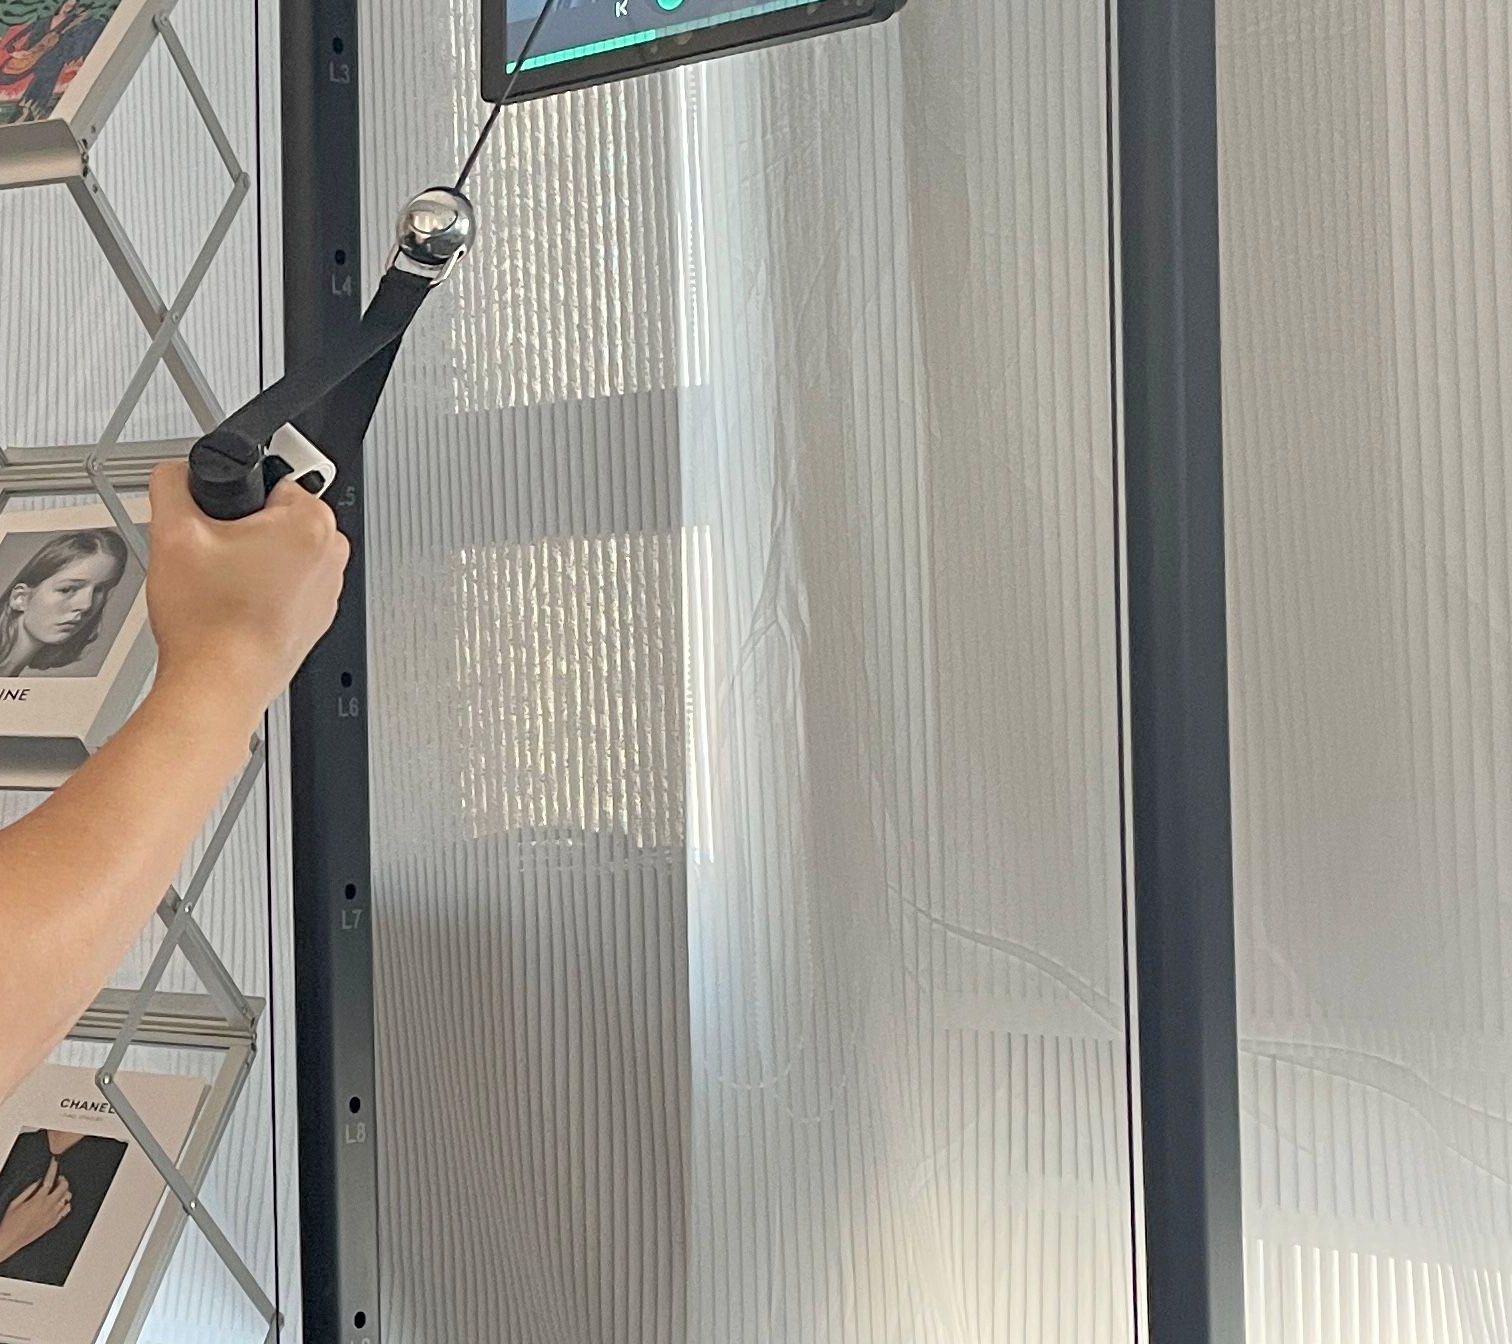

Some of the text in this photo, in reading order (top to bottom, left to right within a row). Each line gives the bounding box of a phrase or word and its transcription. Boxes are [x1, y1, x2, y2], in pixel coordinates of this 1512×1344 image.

[329, 60, 350, 84] L3
[332, 273, 352, 297] L4
[338, 696, 359, 717] L6
[342, 908, 362, 930] L7
[60, 1098, 116, 1115] CHANEL
[346, 1121, 366, 1144] L8
